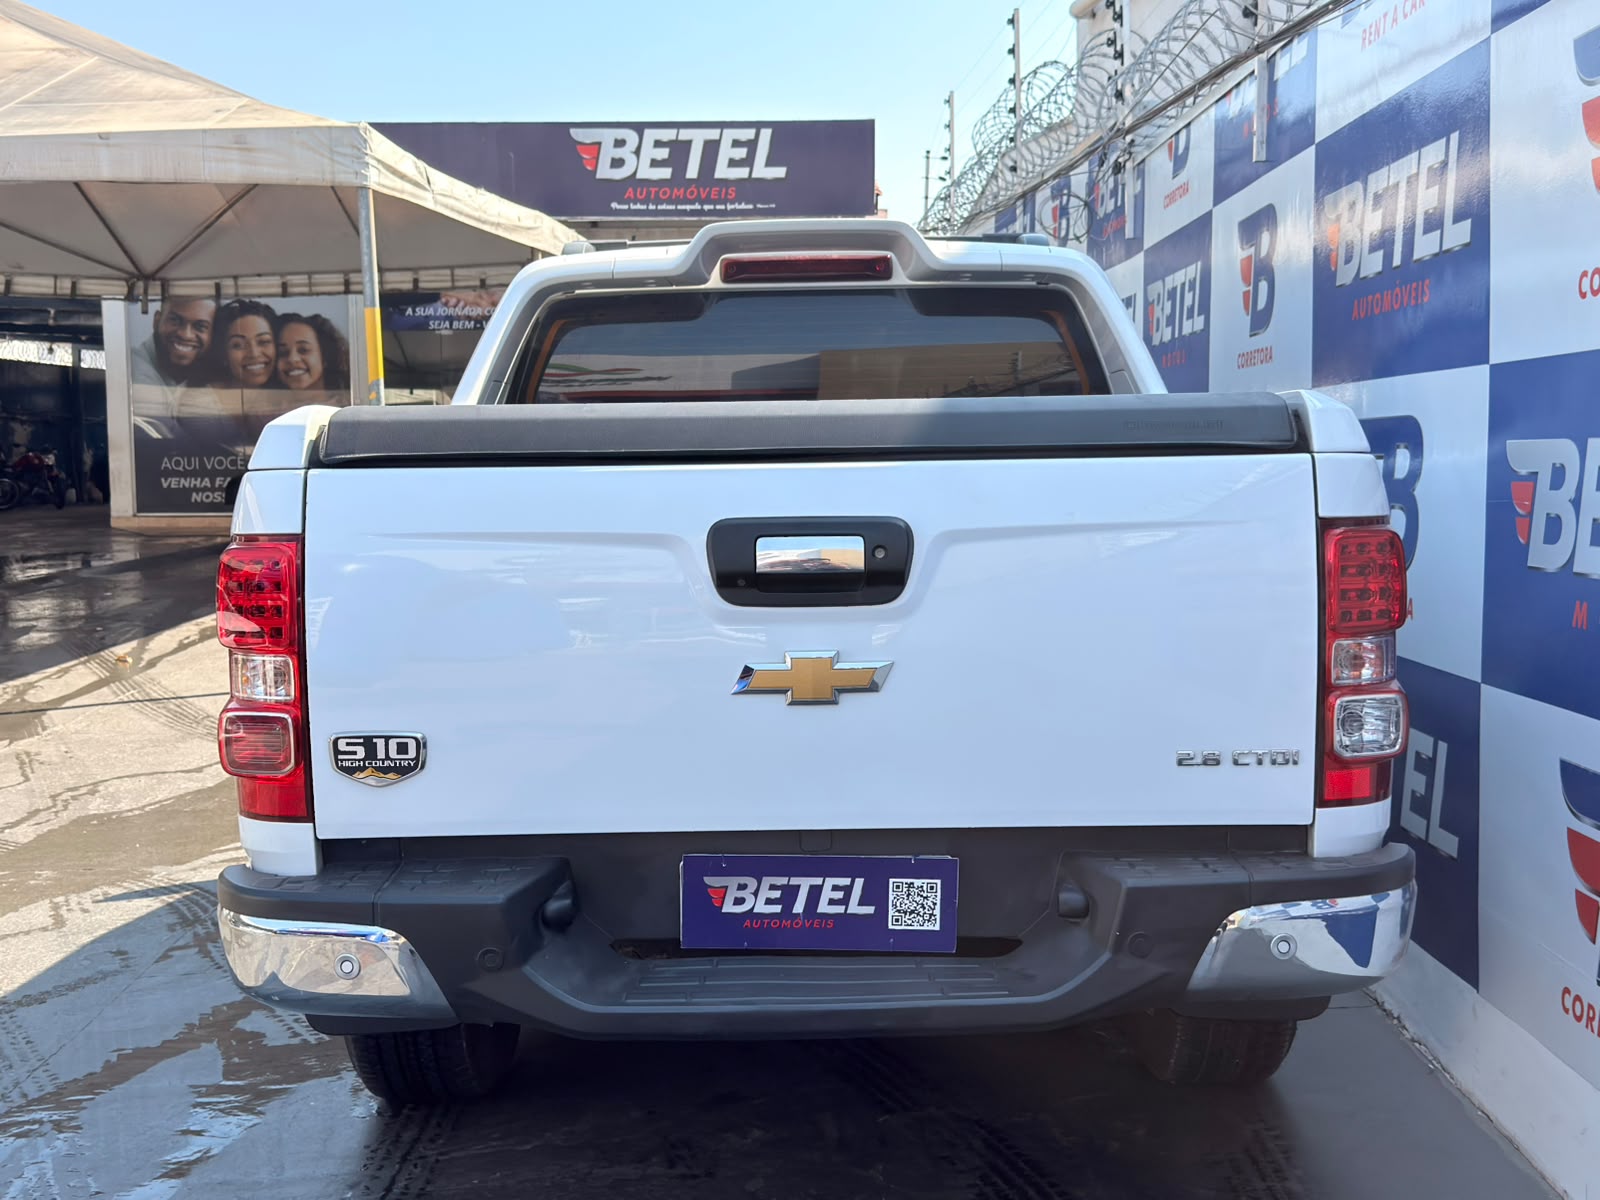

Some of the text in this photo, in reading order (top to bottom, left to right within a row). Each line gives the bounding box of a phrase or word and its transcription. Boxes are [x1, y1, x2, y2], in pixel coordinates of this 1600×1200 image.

[1361, 12, 1388, 50] RENT
[1391, 5, 1398, 30] A
[569, 128, 787, 180] BETEL
[624, 184, 736, 200] AUTOMÓVEIS
[1325, 130, 1472, 288] BETEL
[405, 307, 413, 316] A
[415, 307, 435, 316] SUA
[1147, 261, 1205, 346] BETEL
[1352, 279, 1431, 321] AUTOMÓVEIS
[428, 321, 450, 330] SEJA
[452, 321, 474, 329] BEM
[1237, 346, 1273, 369] CORRETORA
[160, 457, 200, 471] AQUI
[161, 477, 211, 488] VENHA
[703, 876, 876, 914] BETEL
[743, 917, 835, 929] AUTOMÓVEIS
[1561, 986, 1600, 1038] COR
